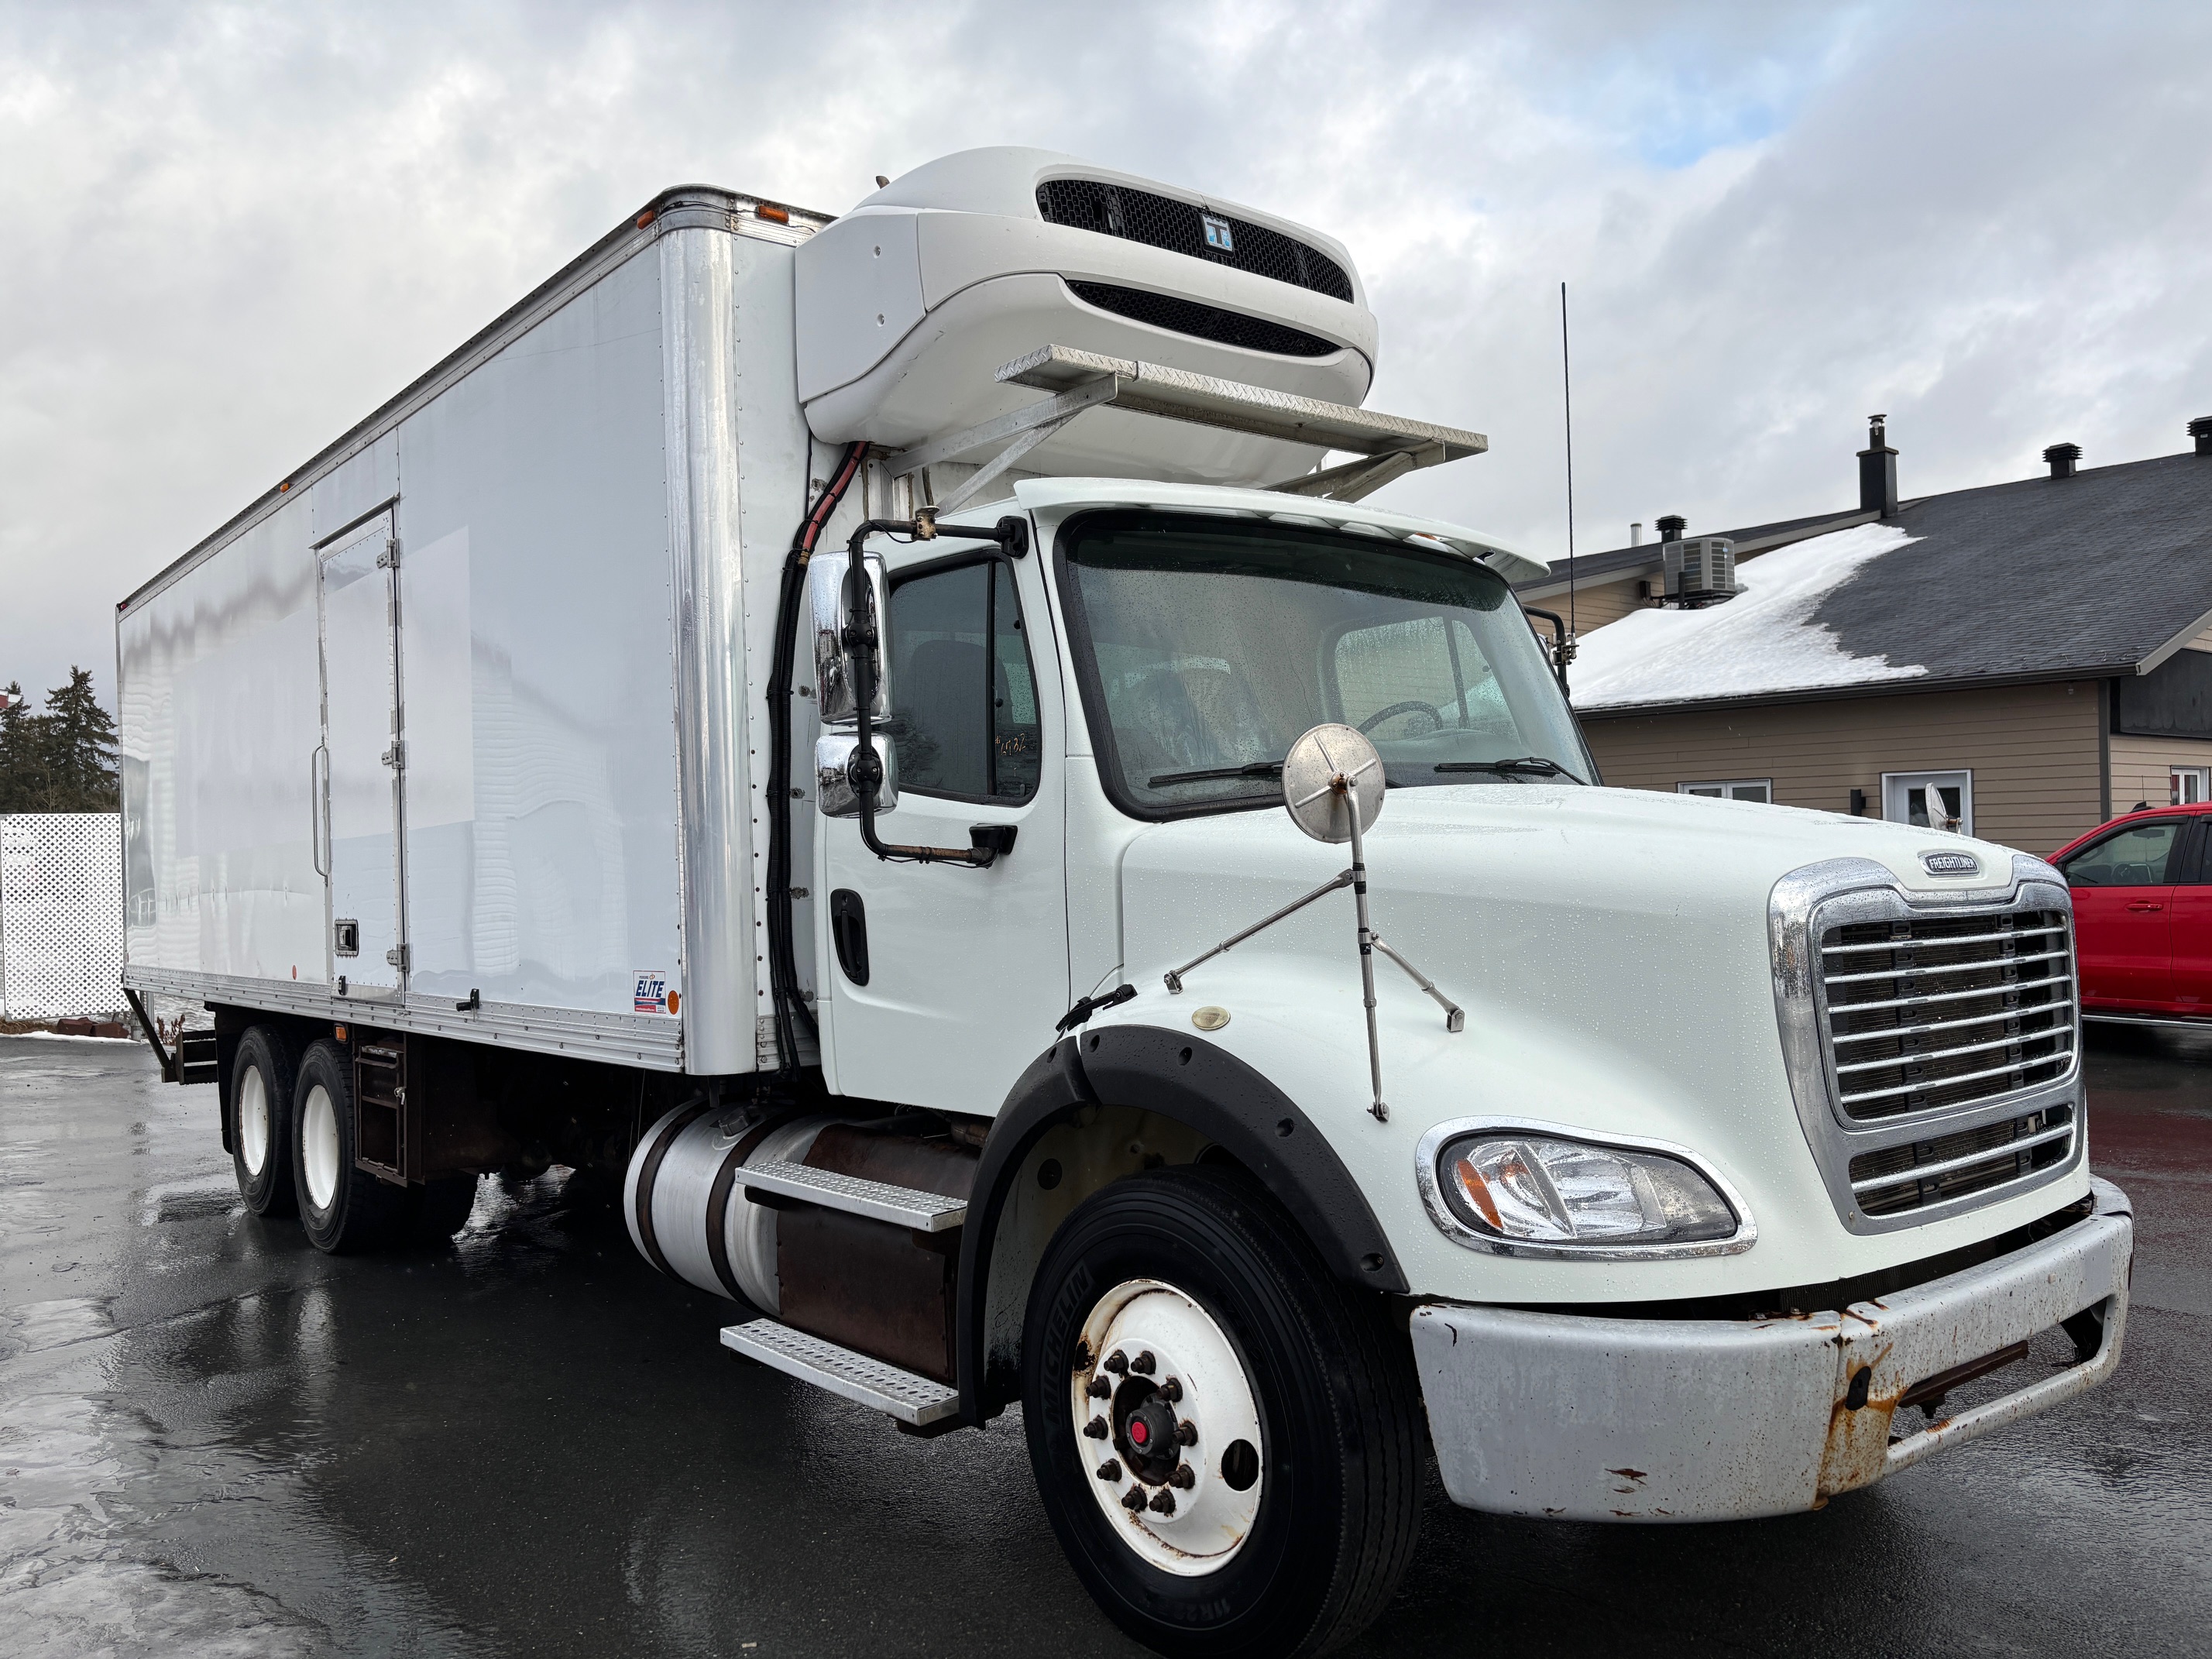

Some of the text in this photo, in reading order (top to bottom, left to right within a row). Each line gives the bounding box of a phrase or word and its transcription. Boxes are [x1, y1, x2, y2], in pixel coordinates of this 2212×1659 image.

[1928, 856, 1976, 869] FREIGHTLINER
[635, 981, 665, 998] ELITE
[1043, 1265, 1091, 1425] MICHELIN
